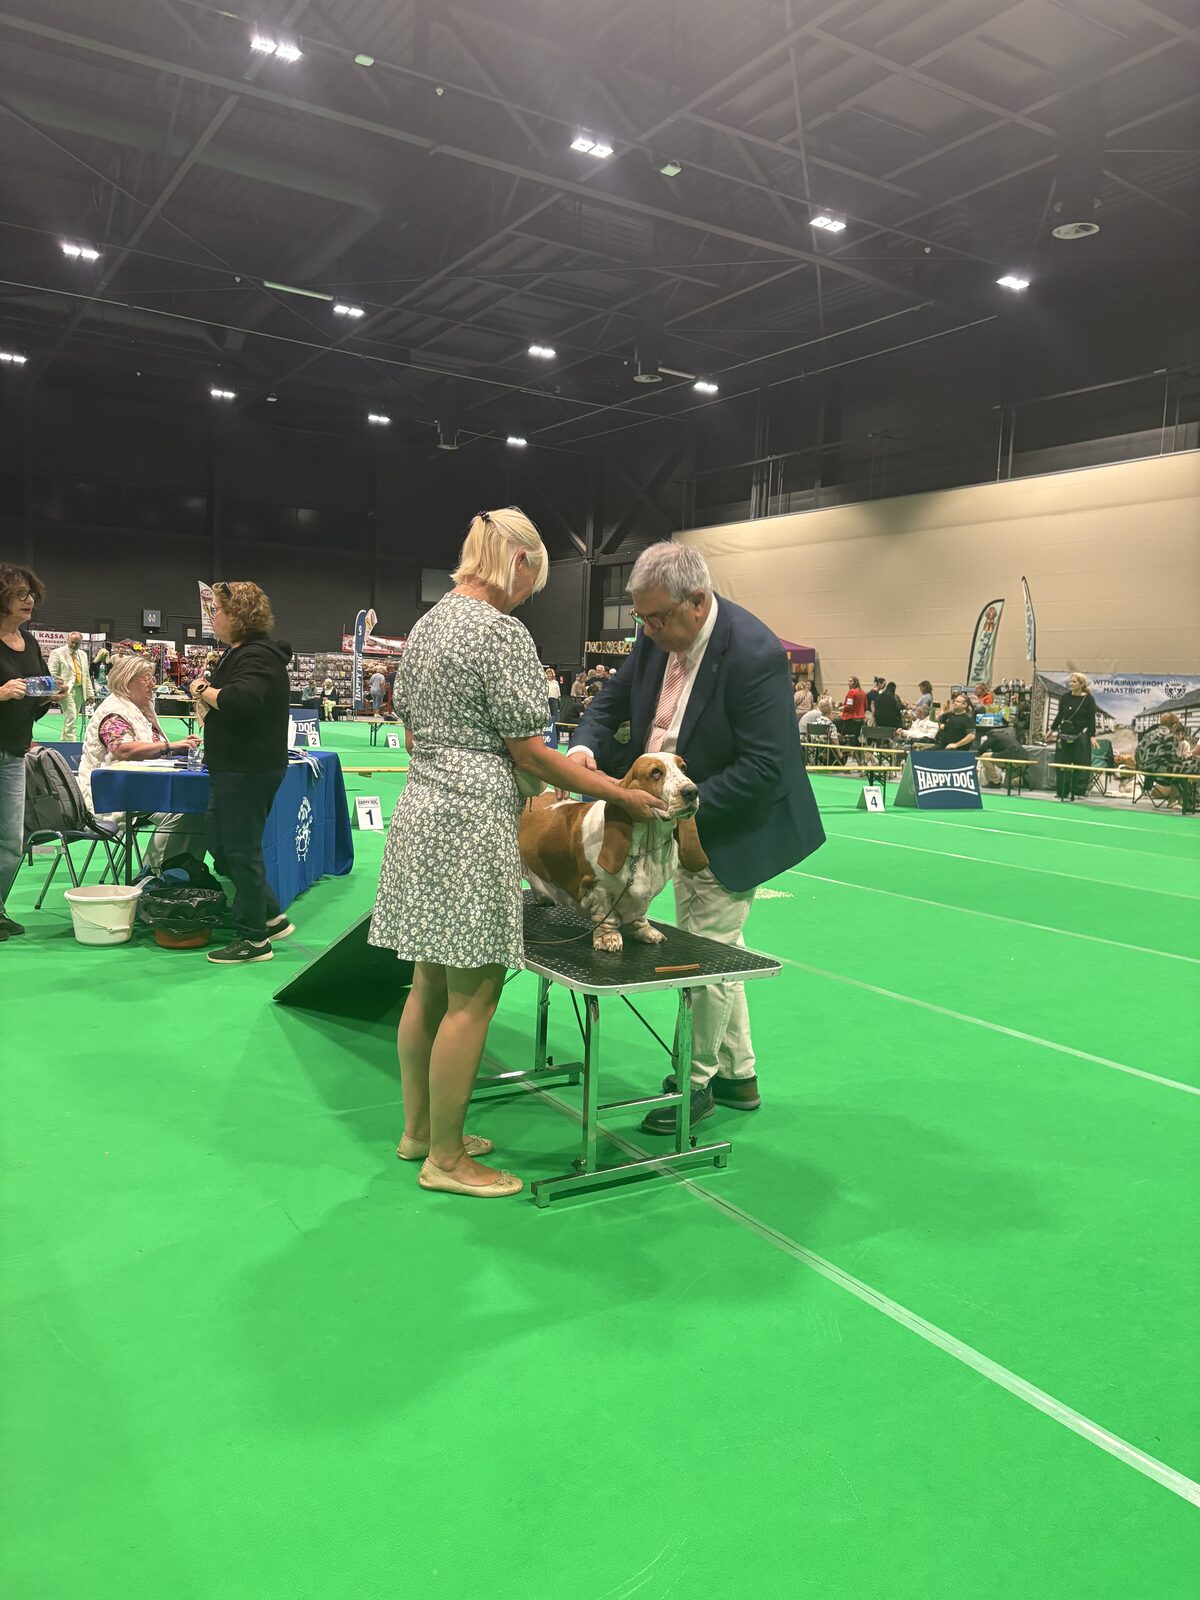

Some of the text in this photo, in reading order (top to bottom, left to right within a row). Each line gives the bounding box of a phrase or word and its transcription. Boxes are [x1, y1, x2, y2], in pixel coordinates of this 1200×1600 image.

[297, 722, 316, 733] DOG
[311, 737, 317, 746] 2
[391, 738, 397, 747] 3
[916, 770, 975, 790] HAPPY DOG
[870, 796, 878, 808] 4
[366, 809, 374, 826] 1
